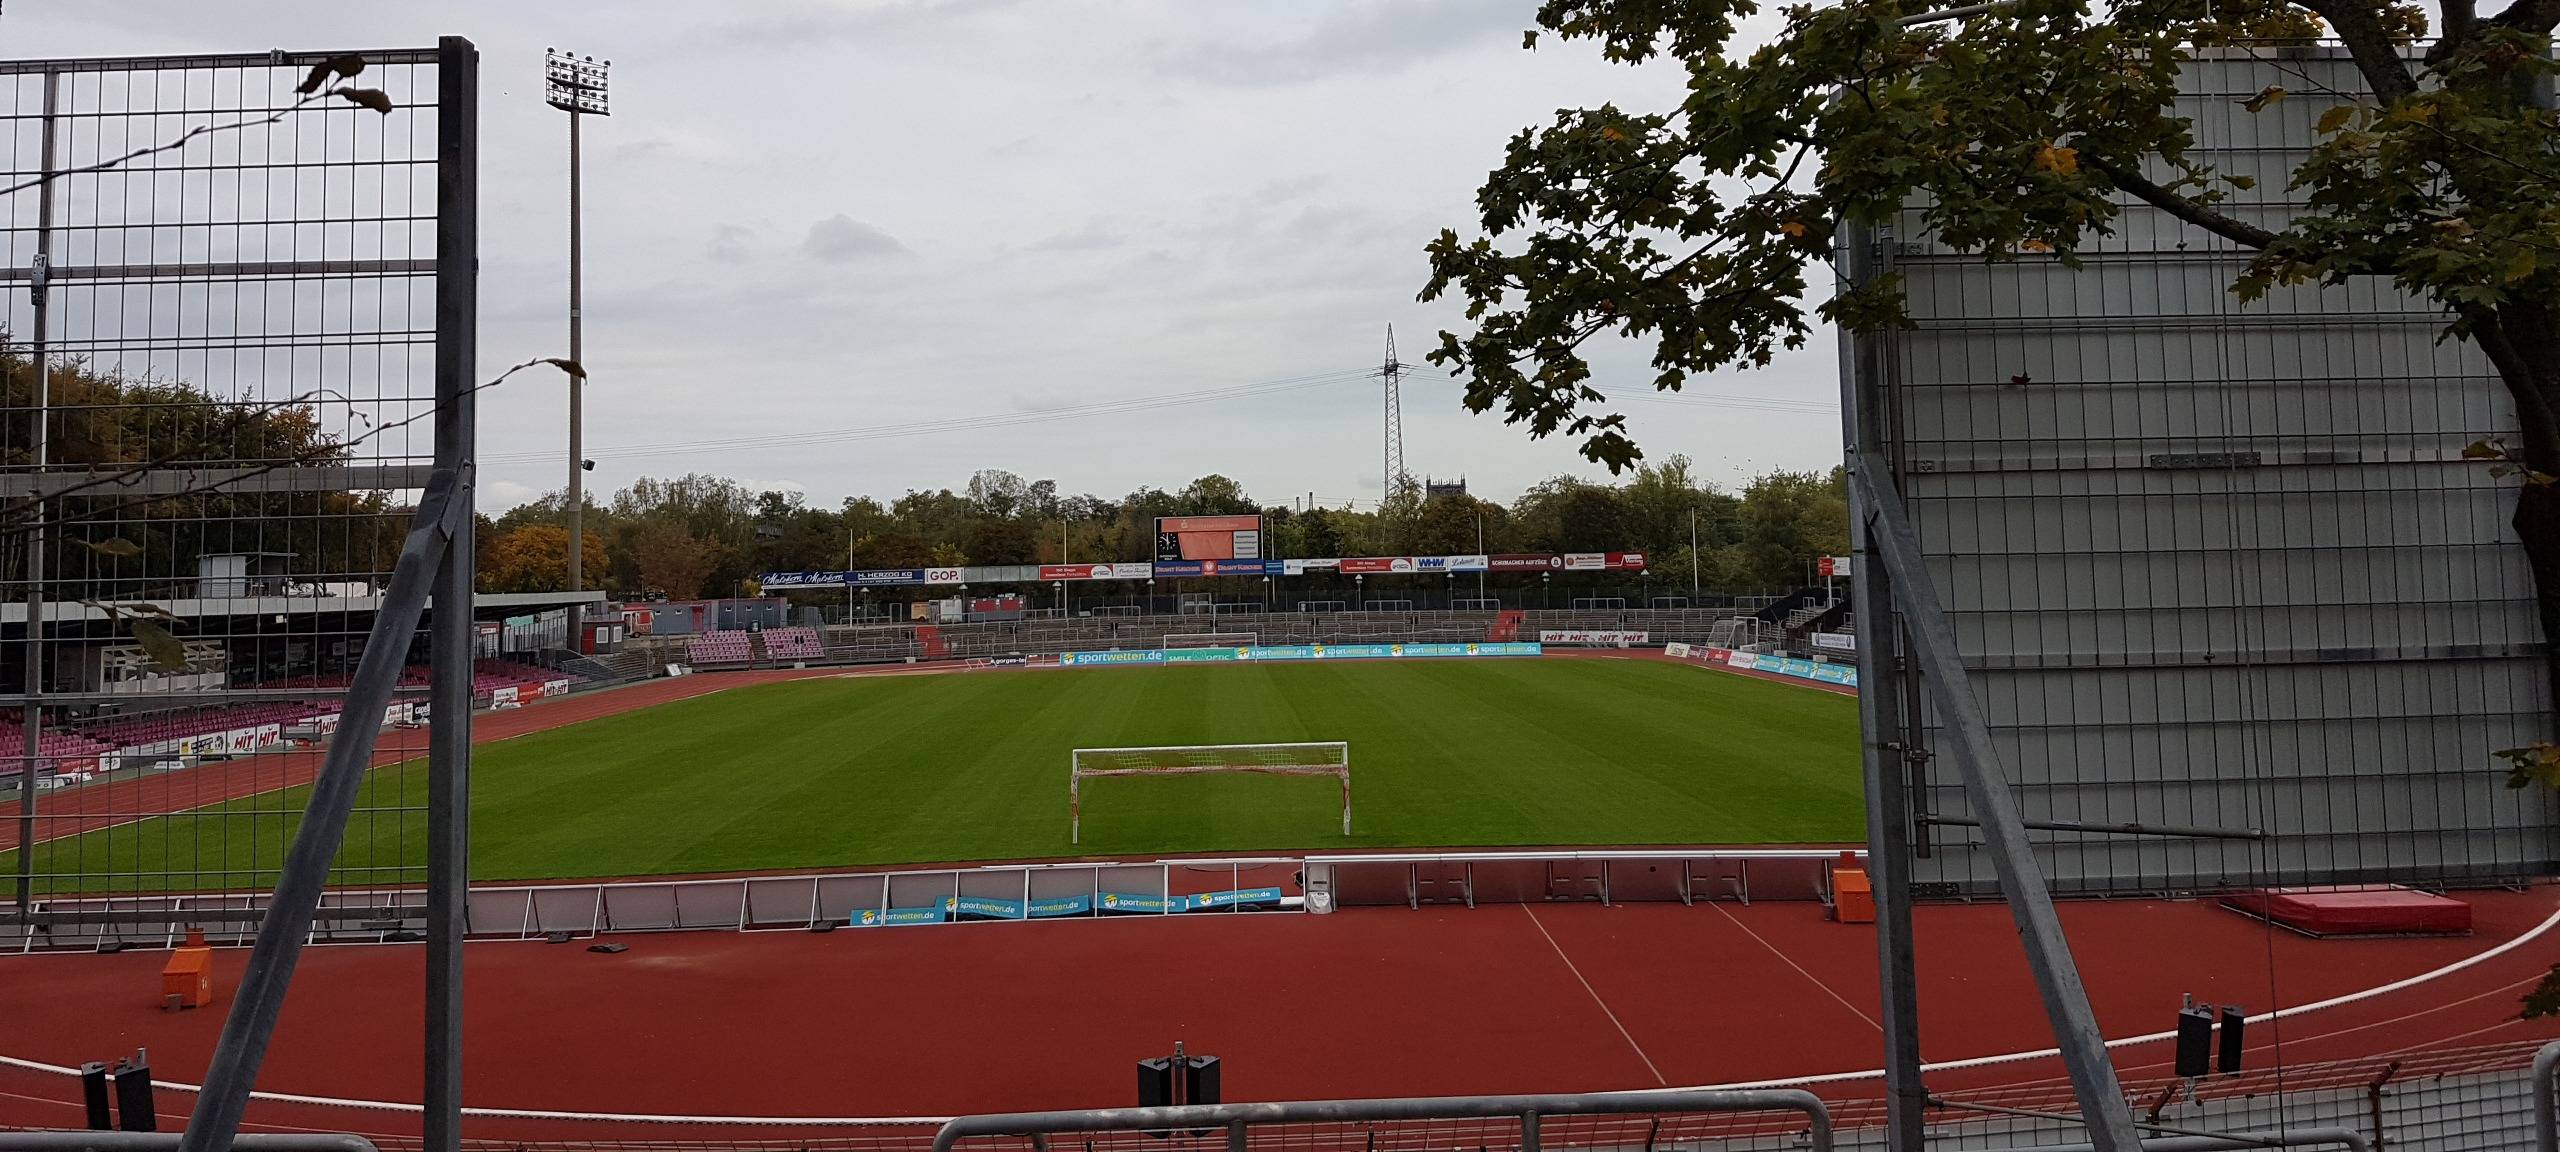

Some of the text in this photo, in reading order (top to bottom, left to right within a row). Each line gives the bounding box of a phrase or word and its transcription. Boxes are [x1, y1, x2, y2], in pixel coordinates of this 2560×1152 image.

[930, 570, 959, 581] GOP.
[1545, 633, 1565, 641] HIT
[1623, 633, 1644, 642] HIT
[1078, 651, 1162, 663] sportwetten.de
[234, 731, 278, 749] HIT HIT
[1214, 891, 1271, 902] sportwetten.de
[960, 901, 1016, 913] sportwetten.de
[1027, 901, 1079, 914] portwetten.de
